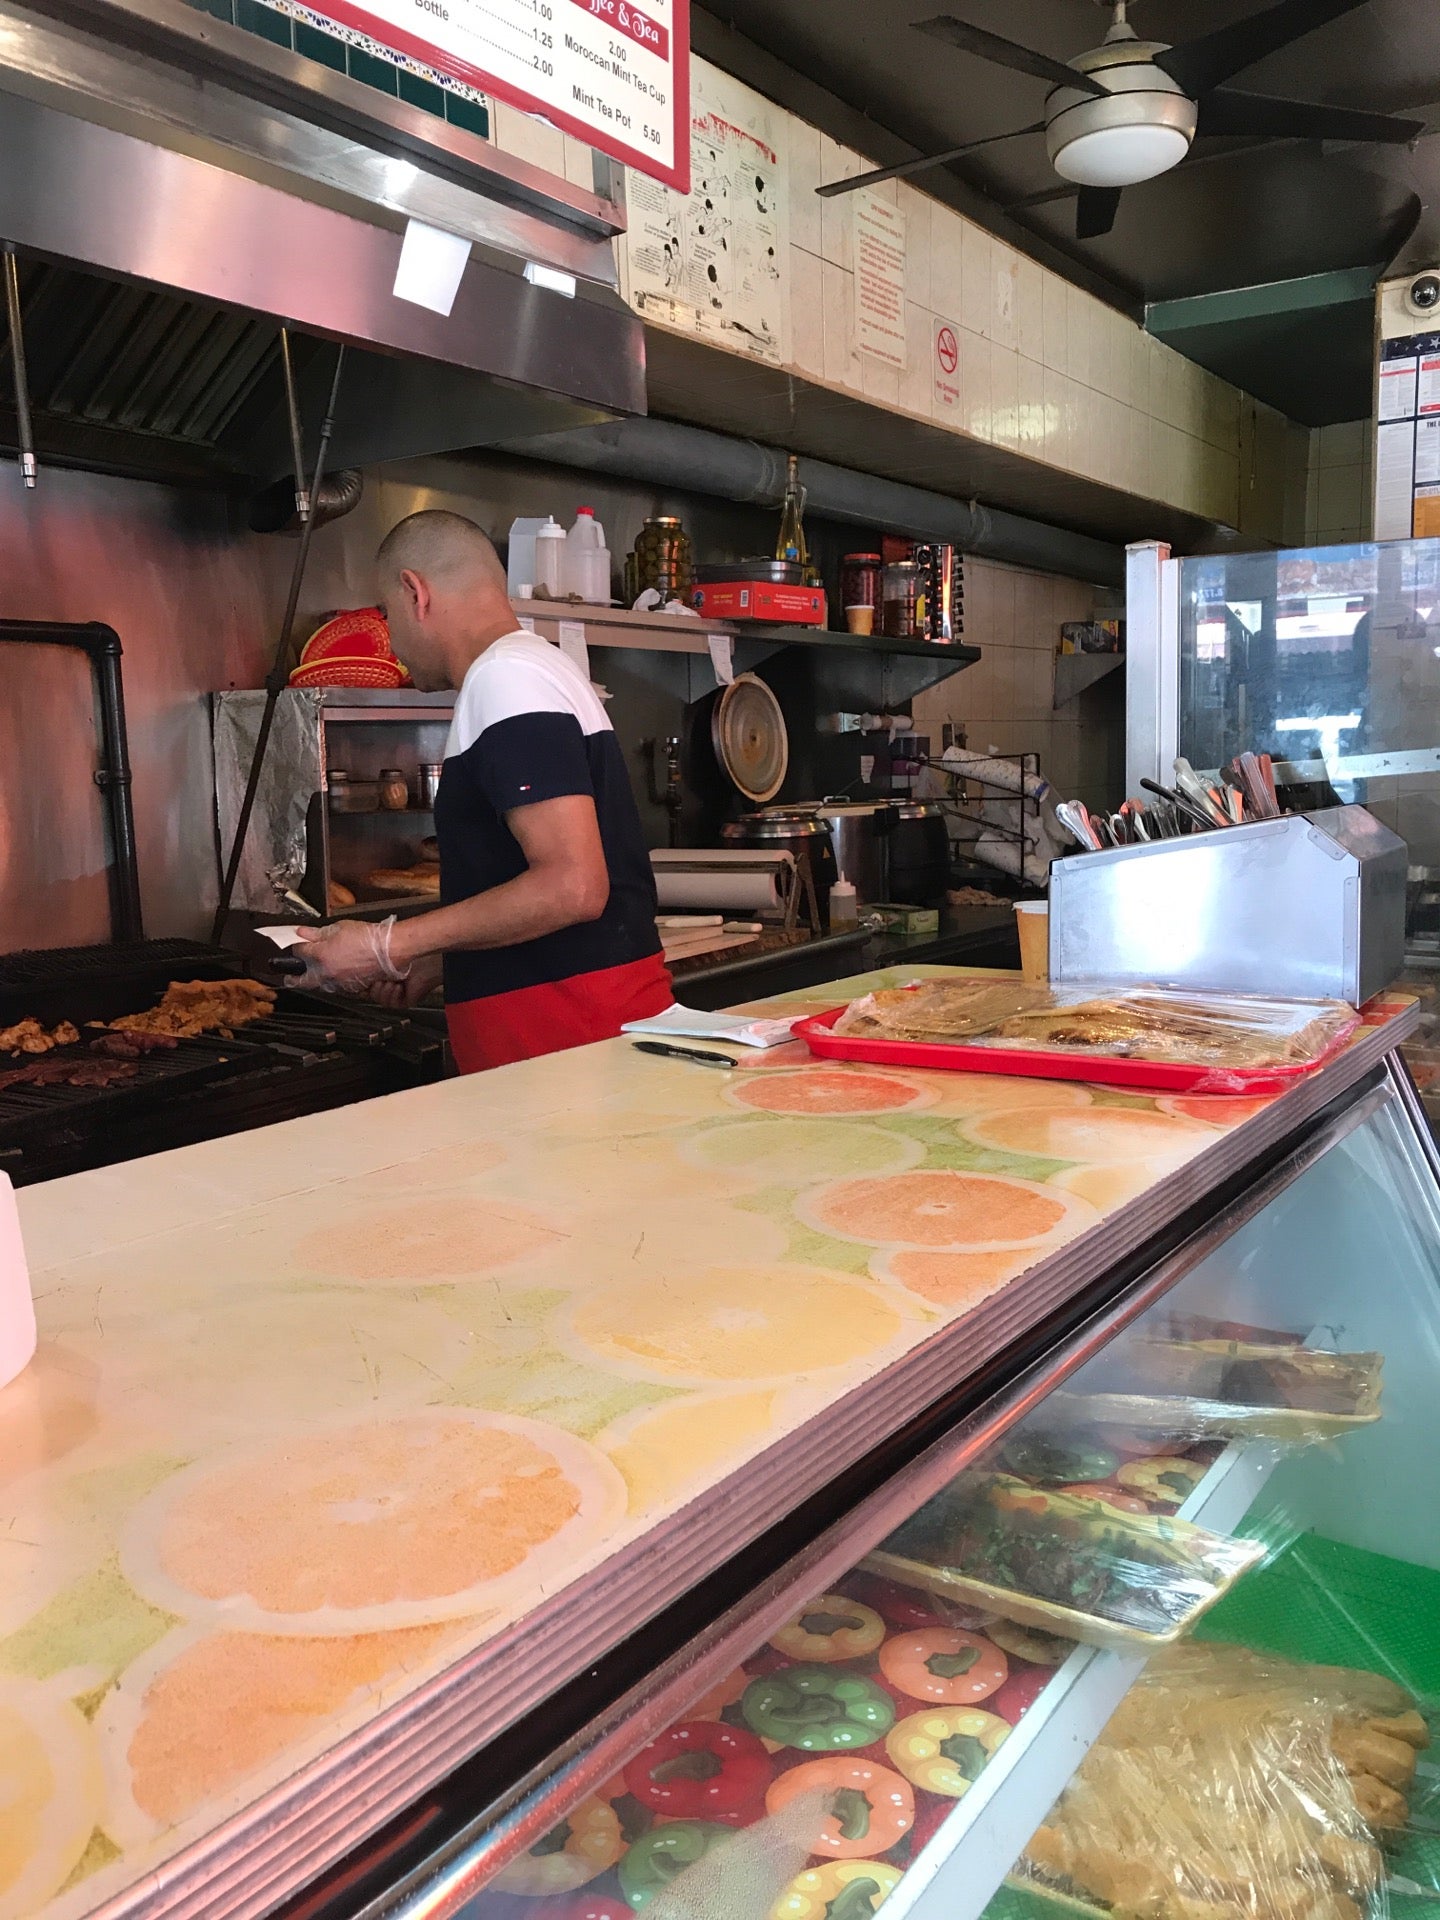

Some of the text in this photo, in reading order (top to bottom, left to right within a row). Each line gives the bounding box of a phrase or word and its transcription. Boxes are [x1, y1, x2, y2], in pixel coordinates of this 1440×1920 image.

[414, 0, 449, 21] Bottle
[532, 0, 553, 21] 1.00
[618, 2, 631, 29] &
[632, 12, 660, 45] Tea
[532, 27, 553, 50] 1.25
[608, 40, 627, 62] 2.00
[533, 55, 554, 77] 2.00
[564, 33, 666, 107] Moroccan Mint Tea Cup
[572, 84, 661, 145] Mint Tea Pot 5.50
